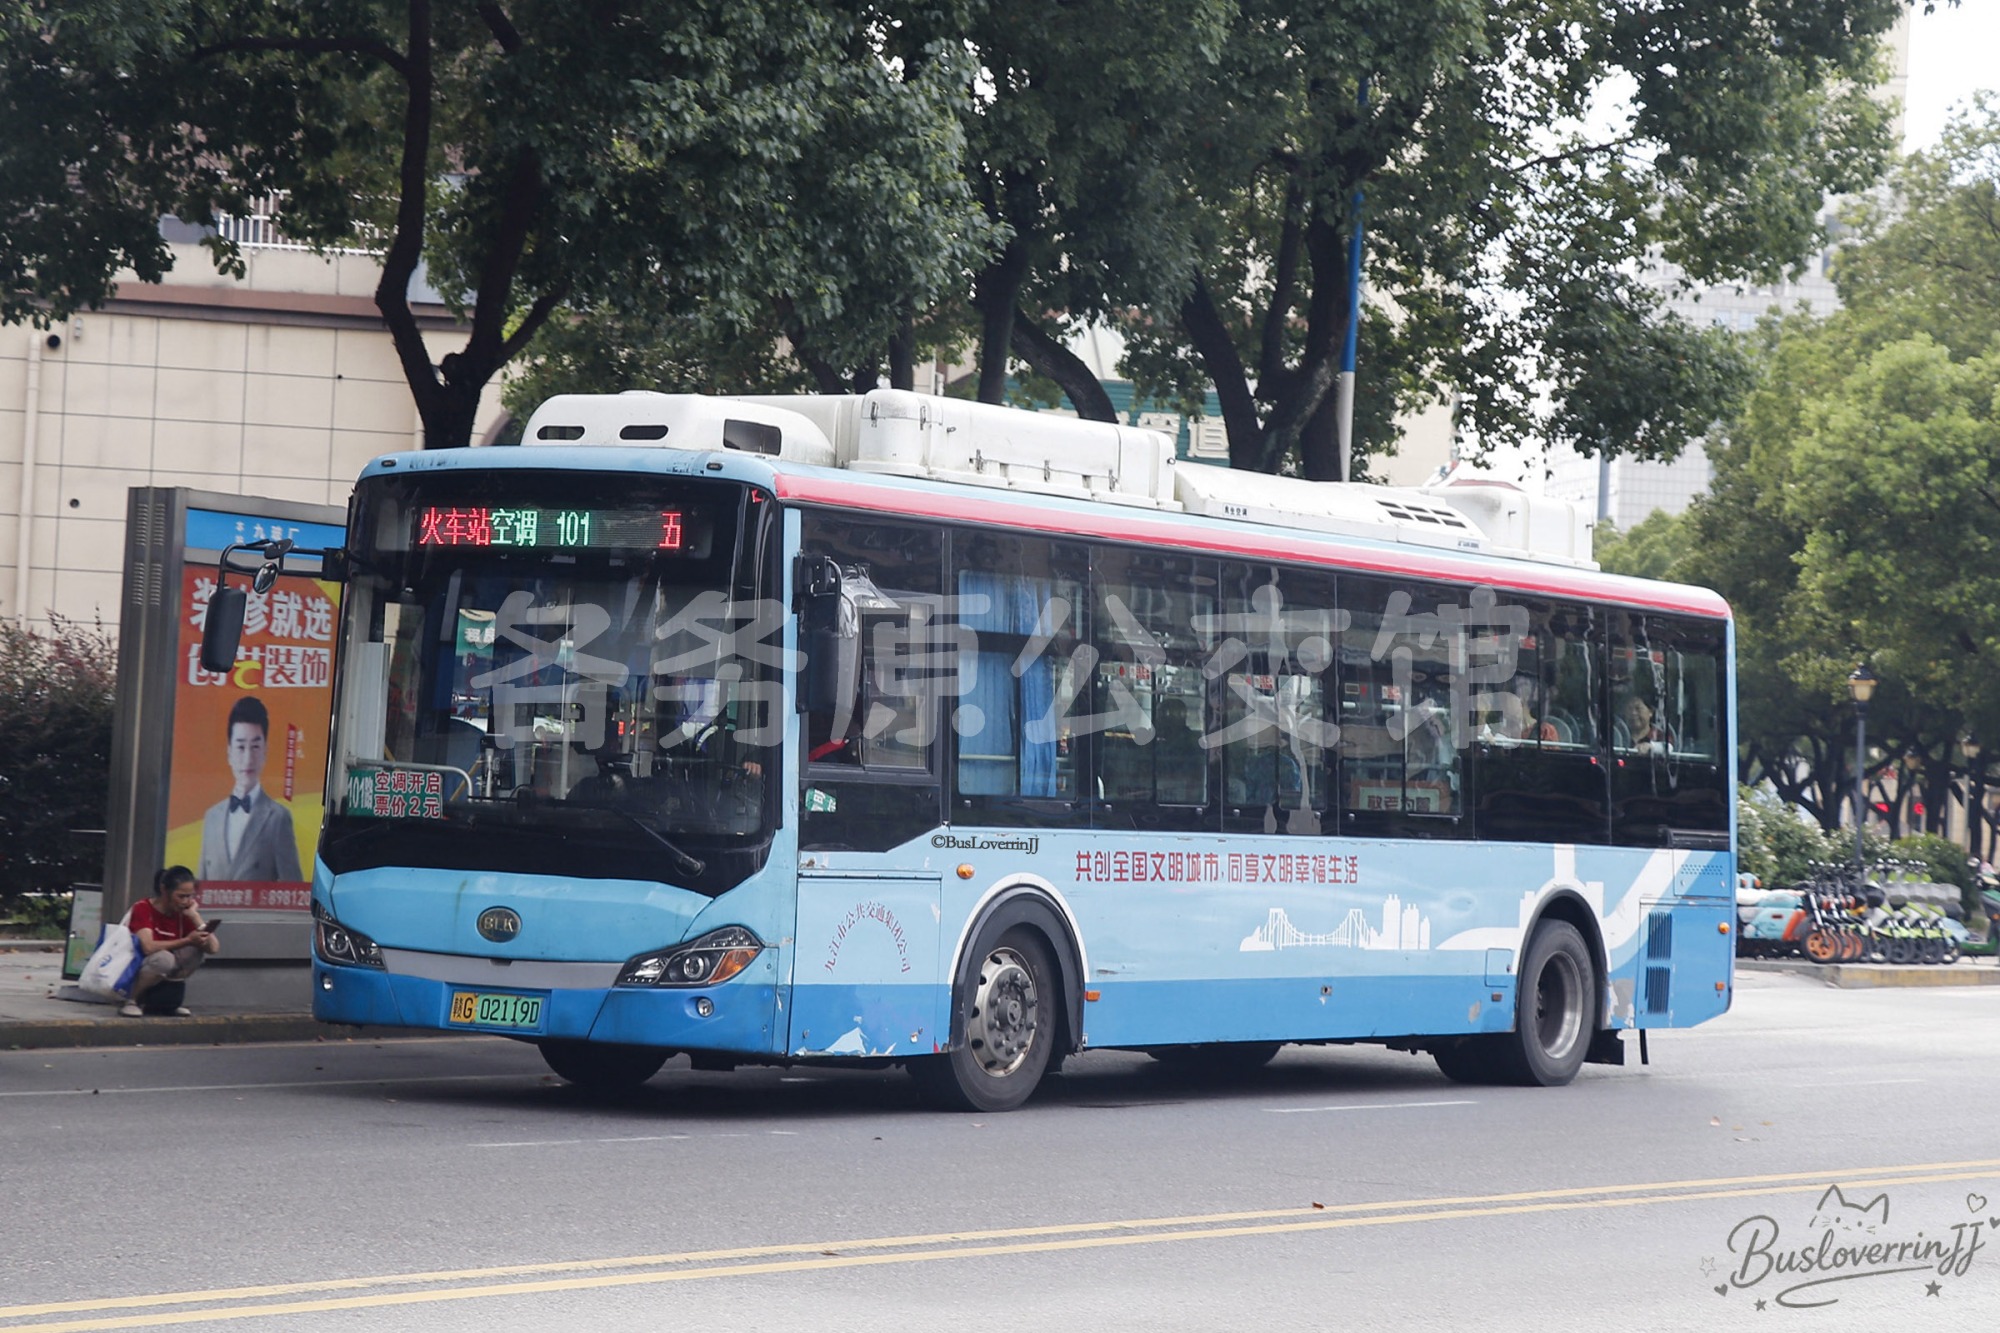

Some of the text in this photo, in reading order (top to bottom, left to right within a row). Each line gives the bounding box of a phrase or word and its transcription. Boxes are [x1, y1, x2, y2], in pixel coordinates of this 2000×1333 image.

[556, 511, 590, 546] 101
[659, 512, 682, 548] 五
[375, 771, 442, 794] 空调开启
[374, 794, 441, 818] 票价2元
